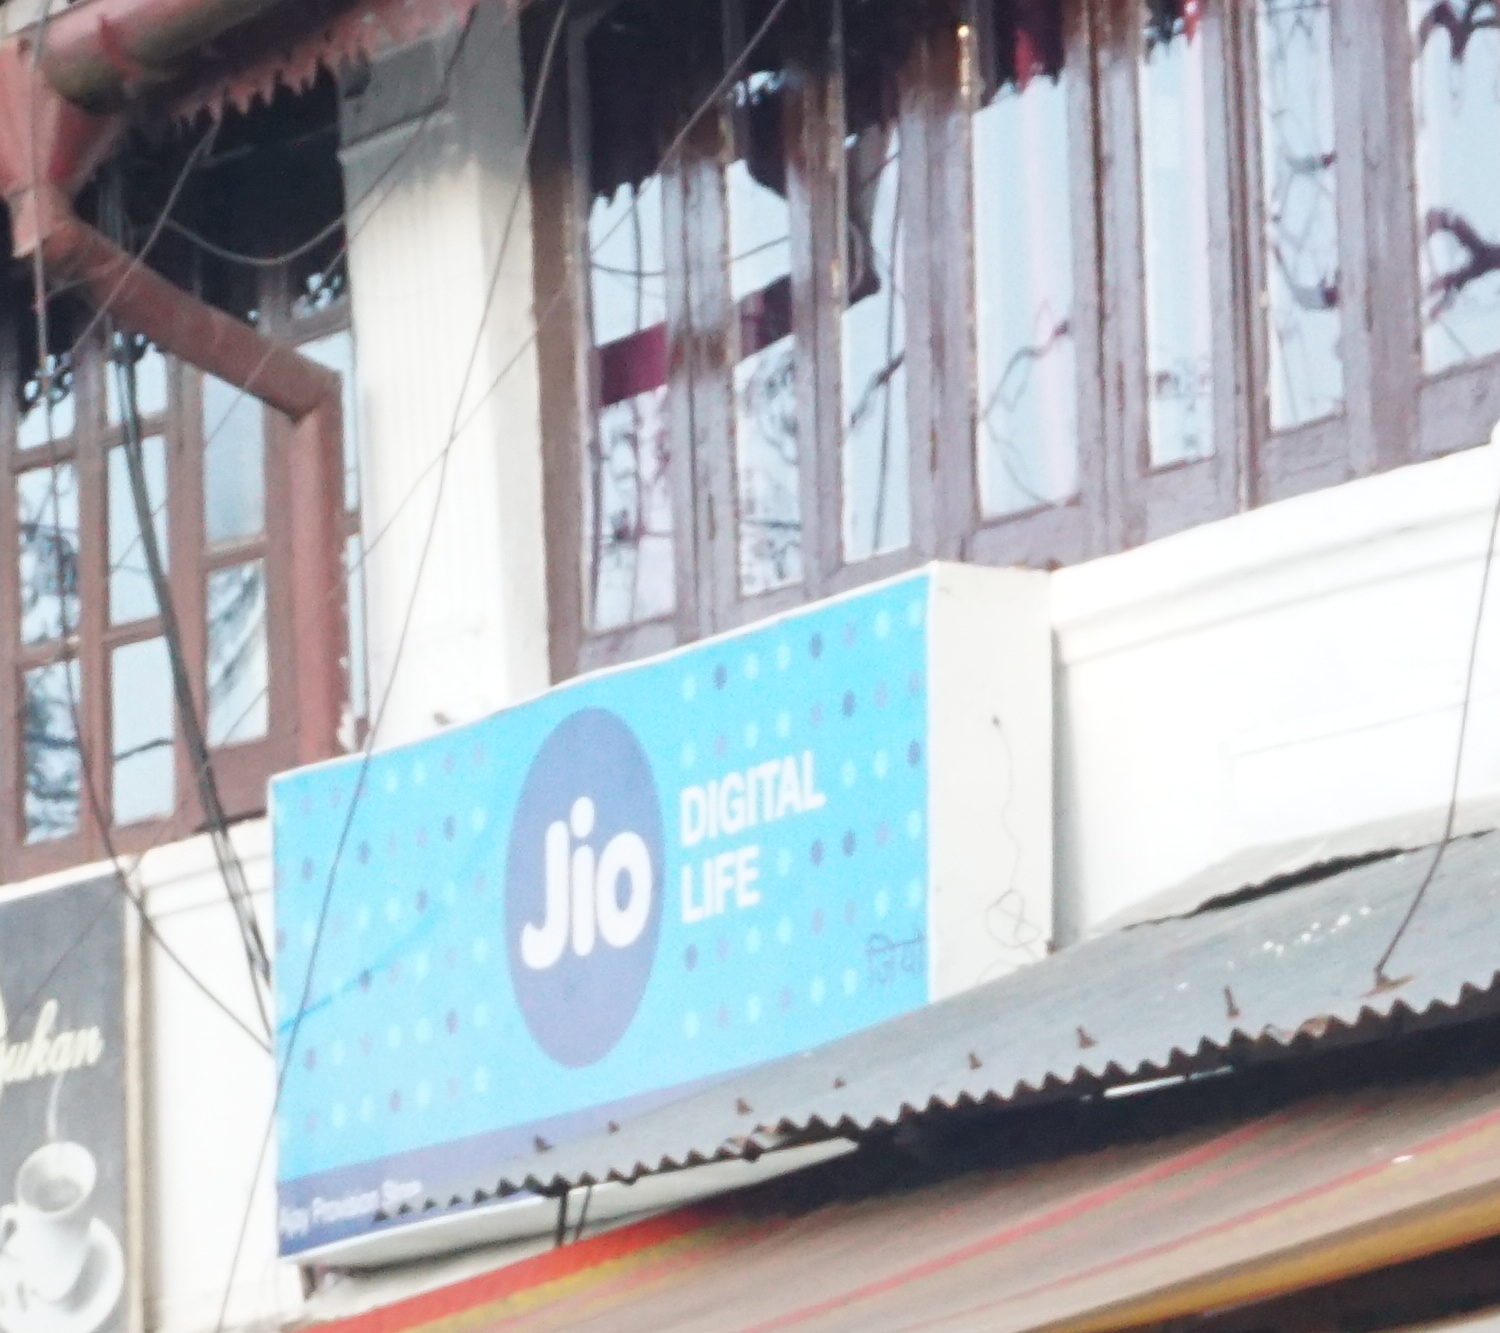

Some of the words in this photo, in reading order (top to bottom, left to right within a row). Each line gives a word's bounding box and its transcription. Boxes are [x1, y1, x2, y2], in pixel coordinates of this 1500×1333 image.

[680, 751, 826, 847] DIGITAL
[520, 797, 652, 969] Jio
[681, 847, 760, 923] LIFE
